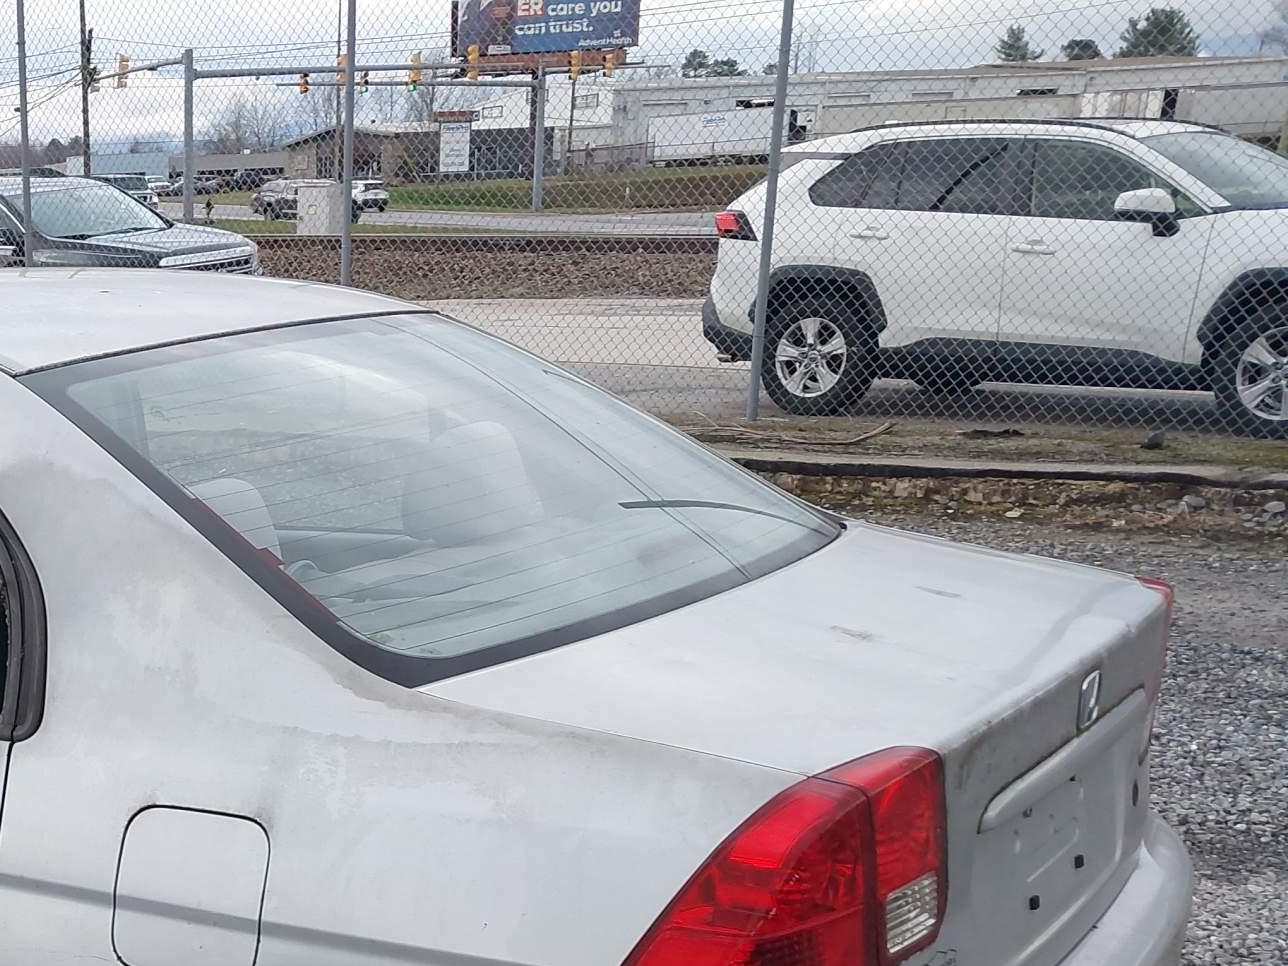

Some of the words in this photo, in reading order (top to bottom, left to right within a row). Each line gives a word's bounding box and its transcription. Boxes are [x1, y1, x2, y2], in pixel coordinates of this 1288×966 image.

[517, 0, 543, 16] ER
[547, 4, 584, 16] care
[590, 1, 622, 17] you
[515, 23, 546, 35] can
[549, 19, 594, 33] trust.
